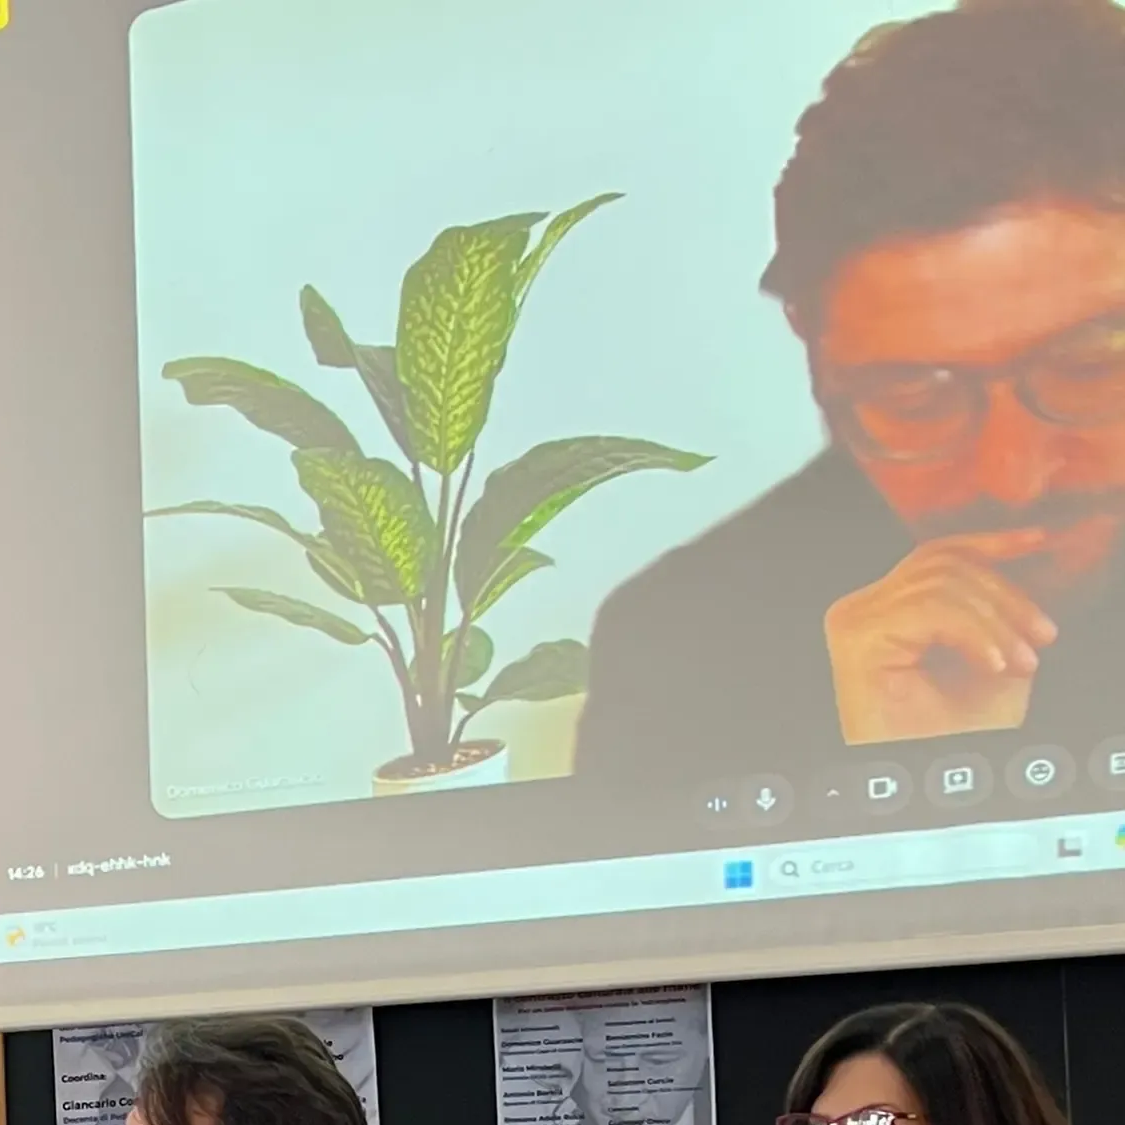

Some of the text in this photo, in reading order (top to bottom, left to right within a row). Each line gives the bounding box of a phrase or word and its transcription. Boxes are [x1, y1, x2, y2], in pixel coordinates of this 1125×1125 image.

[7, 865, 45, 881] 14:26
[810, 856, 855, 876] Cerca
[62, 1098, 116, 1111] Giancarlo
